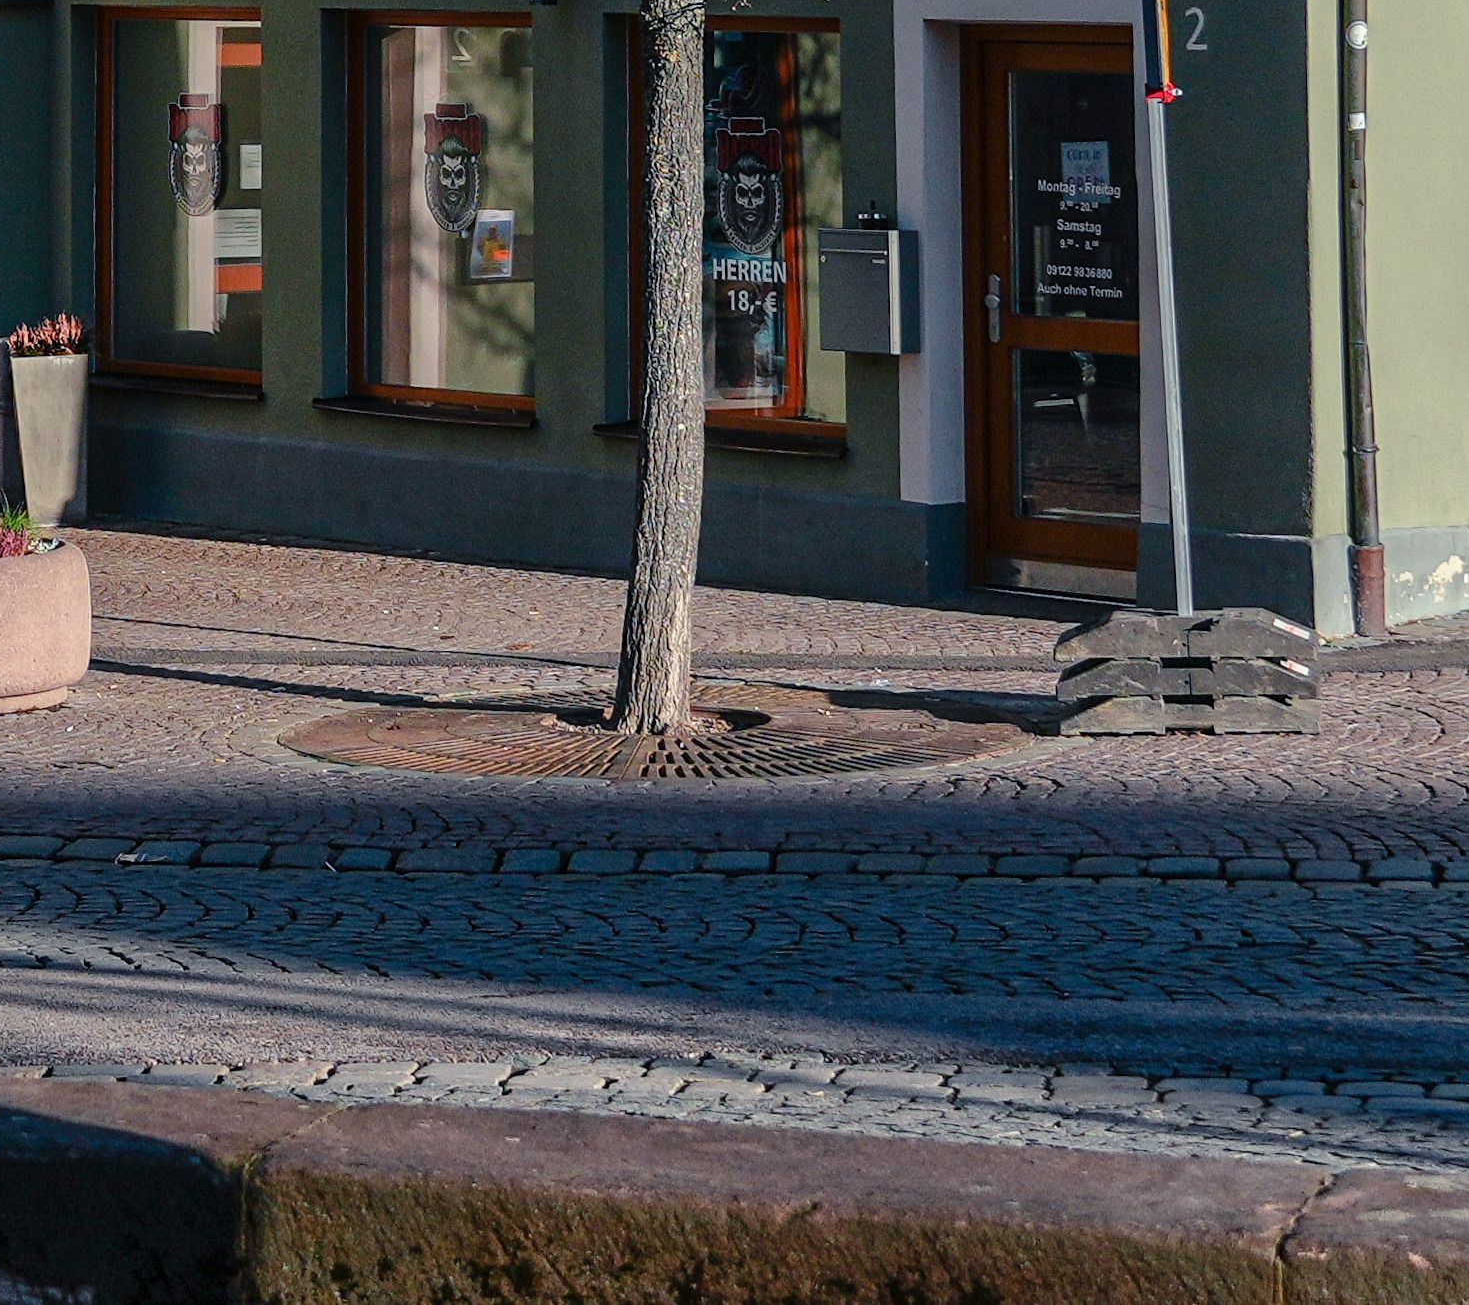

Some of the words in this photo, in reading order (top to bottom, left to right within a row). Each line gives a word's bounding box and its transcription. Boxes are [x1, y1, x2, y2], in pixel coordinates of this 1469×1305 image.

[1185, 6, 1207, 50] 2
[1037, 179, 1076, 196] Montag
[1084, 182, 1121, 199] Freitag
[1056, 218, 1102, 236] Samstag
[713, 258, 787, 284] HERREN
[1037, 282, 1062, 296] Auch
[1064, 284, 1087, 296] ohne
[1089, 285, 1123, 299] Termin
